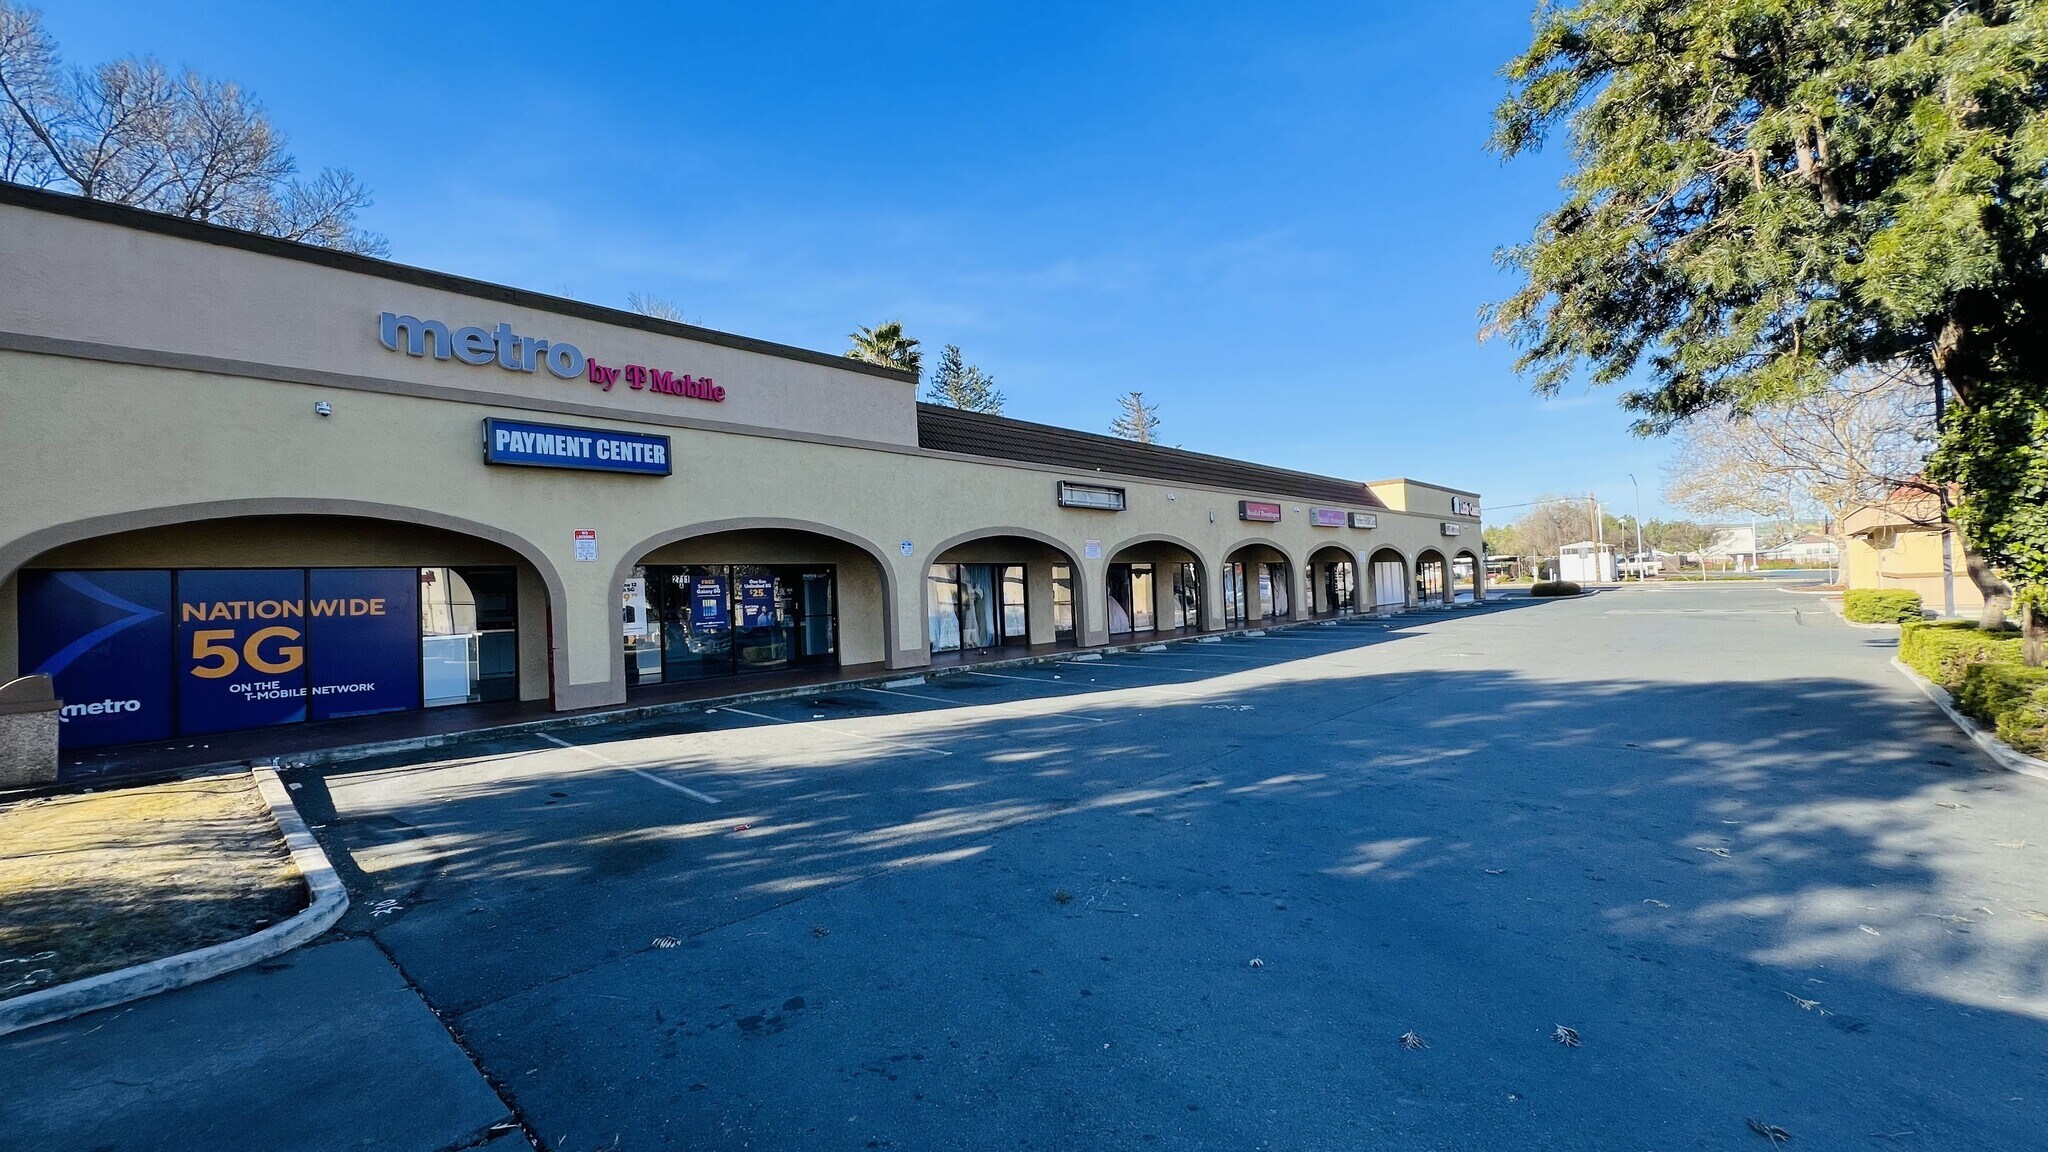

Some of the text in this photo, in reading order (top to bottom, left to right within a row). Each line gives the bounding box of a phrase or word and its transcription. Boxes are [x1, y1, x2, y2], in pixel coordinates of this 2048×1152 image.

[379, 311, 585, 379] metro
[587, 358, 621, 391] by
[649, 368, 726, 402] Mobile
[495, 429, 666, 464] PAYMENT CENTER
[182, 598, 386, 622] NATIONWIDE
[190, 626, 304, 679] 5G
[229, 680, 280, 693] ON THE
[244, 682, 375, 701] T-MOBILE NETWORK
[60, 698, 141, 721] metro
